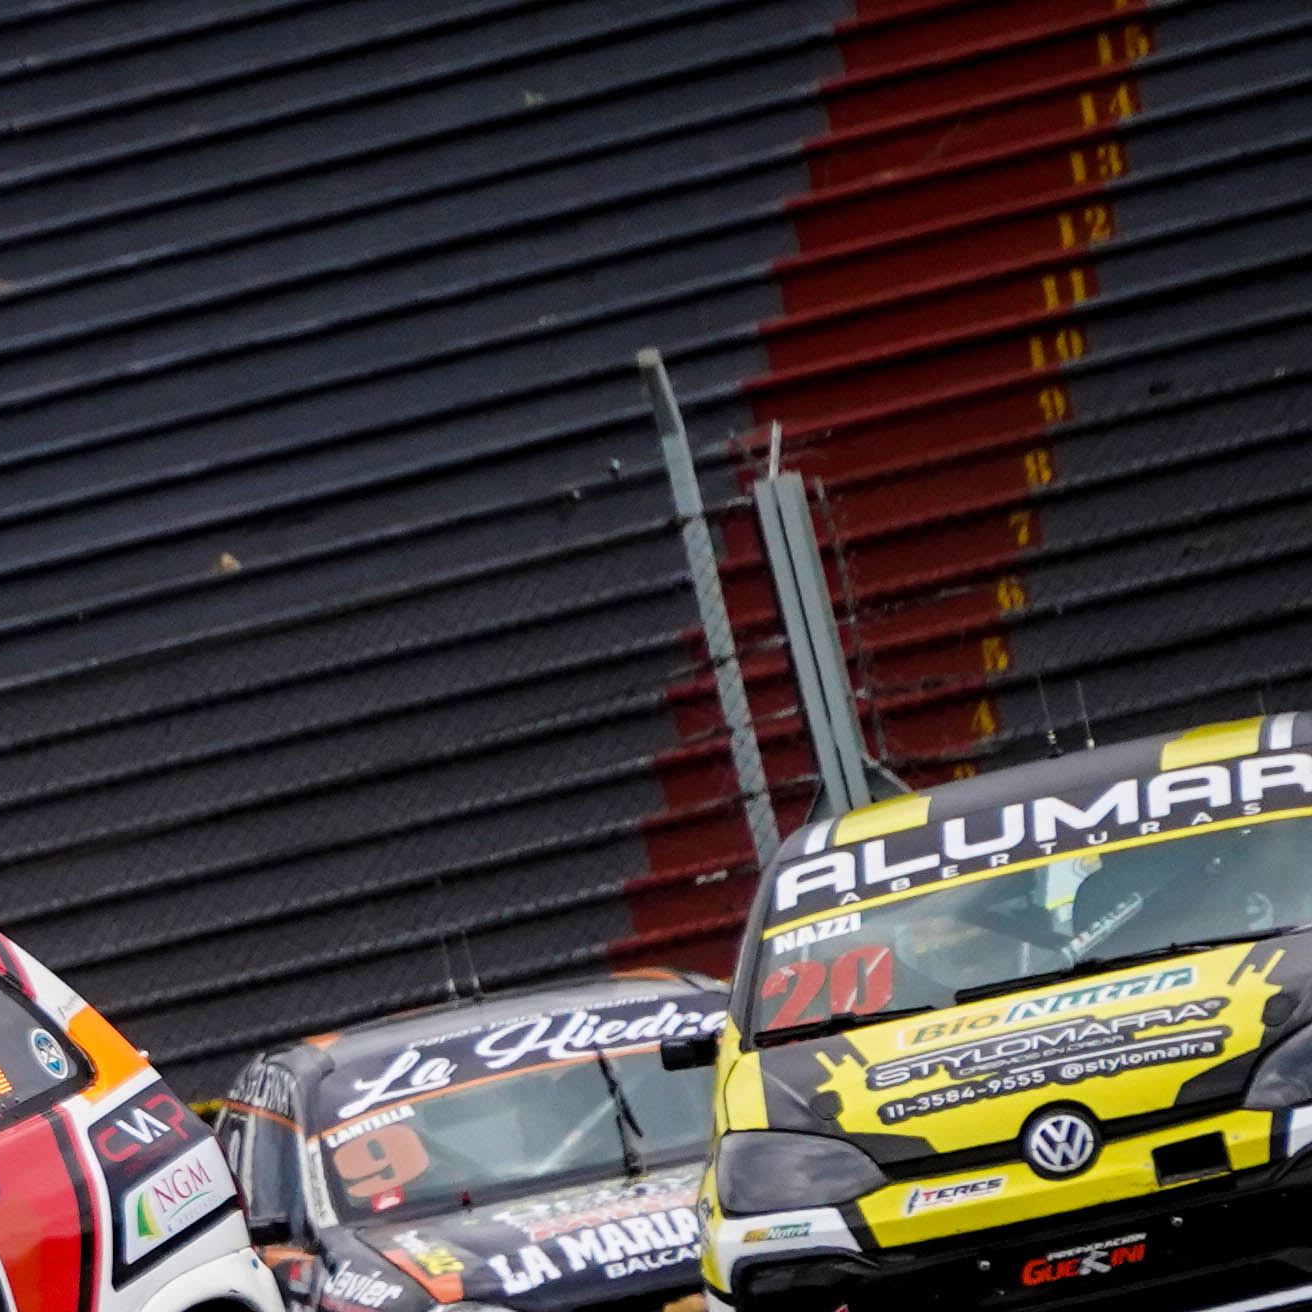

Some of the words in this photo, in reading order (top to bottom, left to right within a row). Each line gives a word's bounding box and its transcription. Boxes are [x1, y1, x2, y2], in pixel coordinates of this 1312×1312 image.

[1079, 81, 1134, 127] 14
[1069, 141, 1124, 184] 13
[1057, 203, 1112, 249] 12
[1041, 268, 1087, 310] 11
[1029, 328, 1085, 369] 10
[1008, 511, 1032, 546] 7
[839, 802, 1262, 905] ABERTURAS
[774, 911, 862, 954] NAZZI
[760, 945, 894, 1035] 20
[338, 1050, 458, 1119] La
[886, 1069, 1047, 1120] 11-3584-9555
[1060, 1039, 1215, 1082] @stylomafra
[333, 1123, 430, 1198] 9
[152, 1158, 214, 1214] NGM
[488, 1244, 563, 1297] LA
